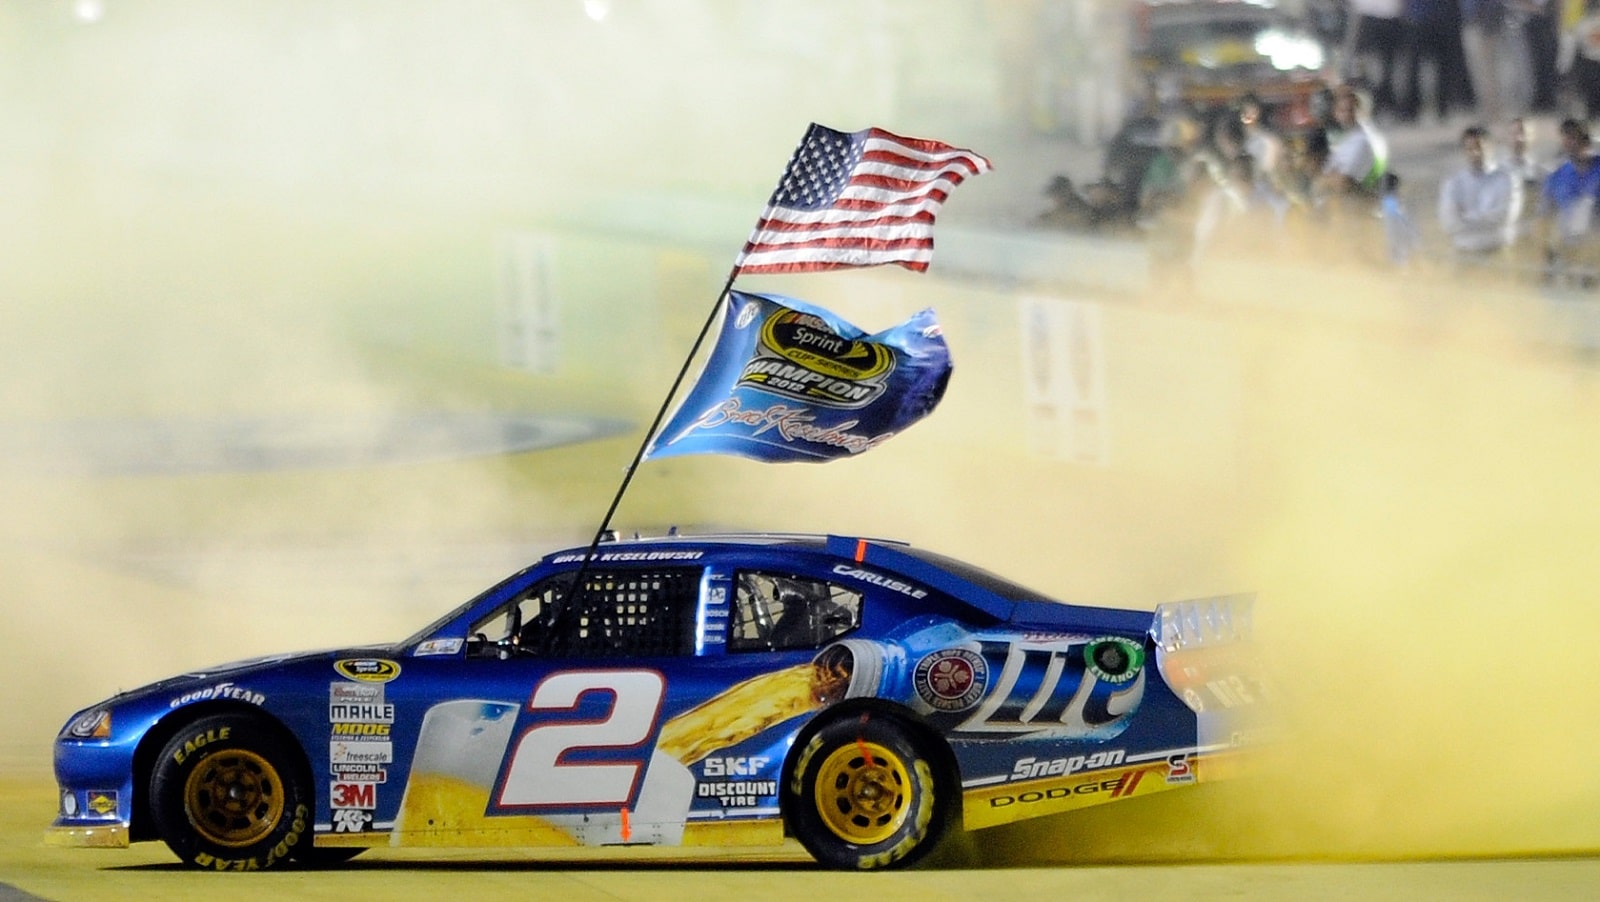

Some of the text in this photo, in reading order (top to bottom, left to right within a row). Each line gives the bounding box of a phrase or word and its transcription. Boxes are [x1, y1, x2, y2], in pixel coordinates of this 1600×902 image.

[792, 327, 843, 354] Sprint
[787, 349, 814, 361] CUP
[743, 361, 869, 400] HAMPION
[767, 377, 806, 394] 2012
[600, 551, 704, 562] KESELOWSKI
[832, 564, 928, 600] CARLISLE
[1090, 665, 1142, 684] ETHANOL
[170, 683, 265, 707] GOODYEAR
[331, 705, 392, 719] MAHLE
[332, 723, 390, 735] MOOG
[496, 667, 667, 808] 2
[172, 727, 231, 765] EAGLE
[703, 757, 770, 777] SKF
[1010, 750, 1125, 781] Snap-on
[333, 784, 373, 807] 3M
[698, 781, 776, 797] DISCOUNT
[989, 779, 1124, 808] DODGE
[719, 796, 756, 806] TIRE
